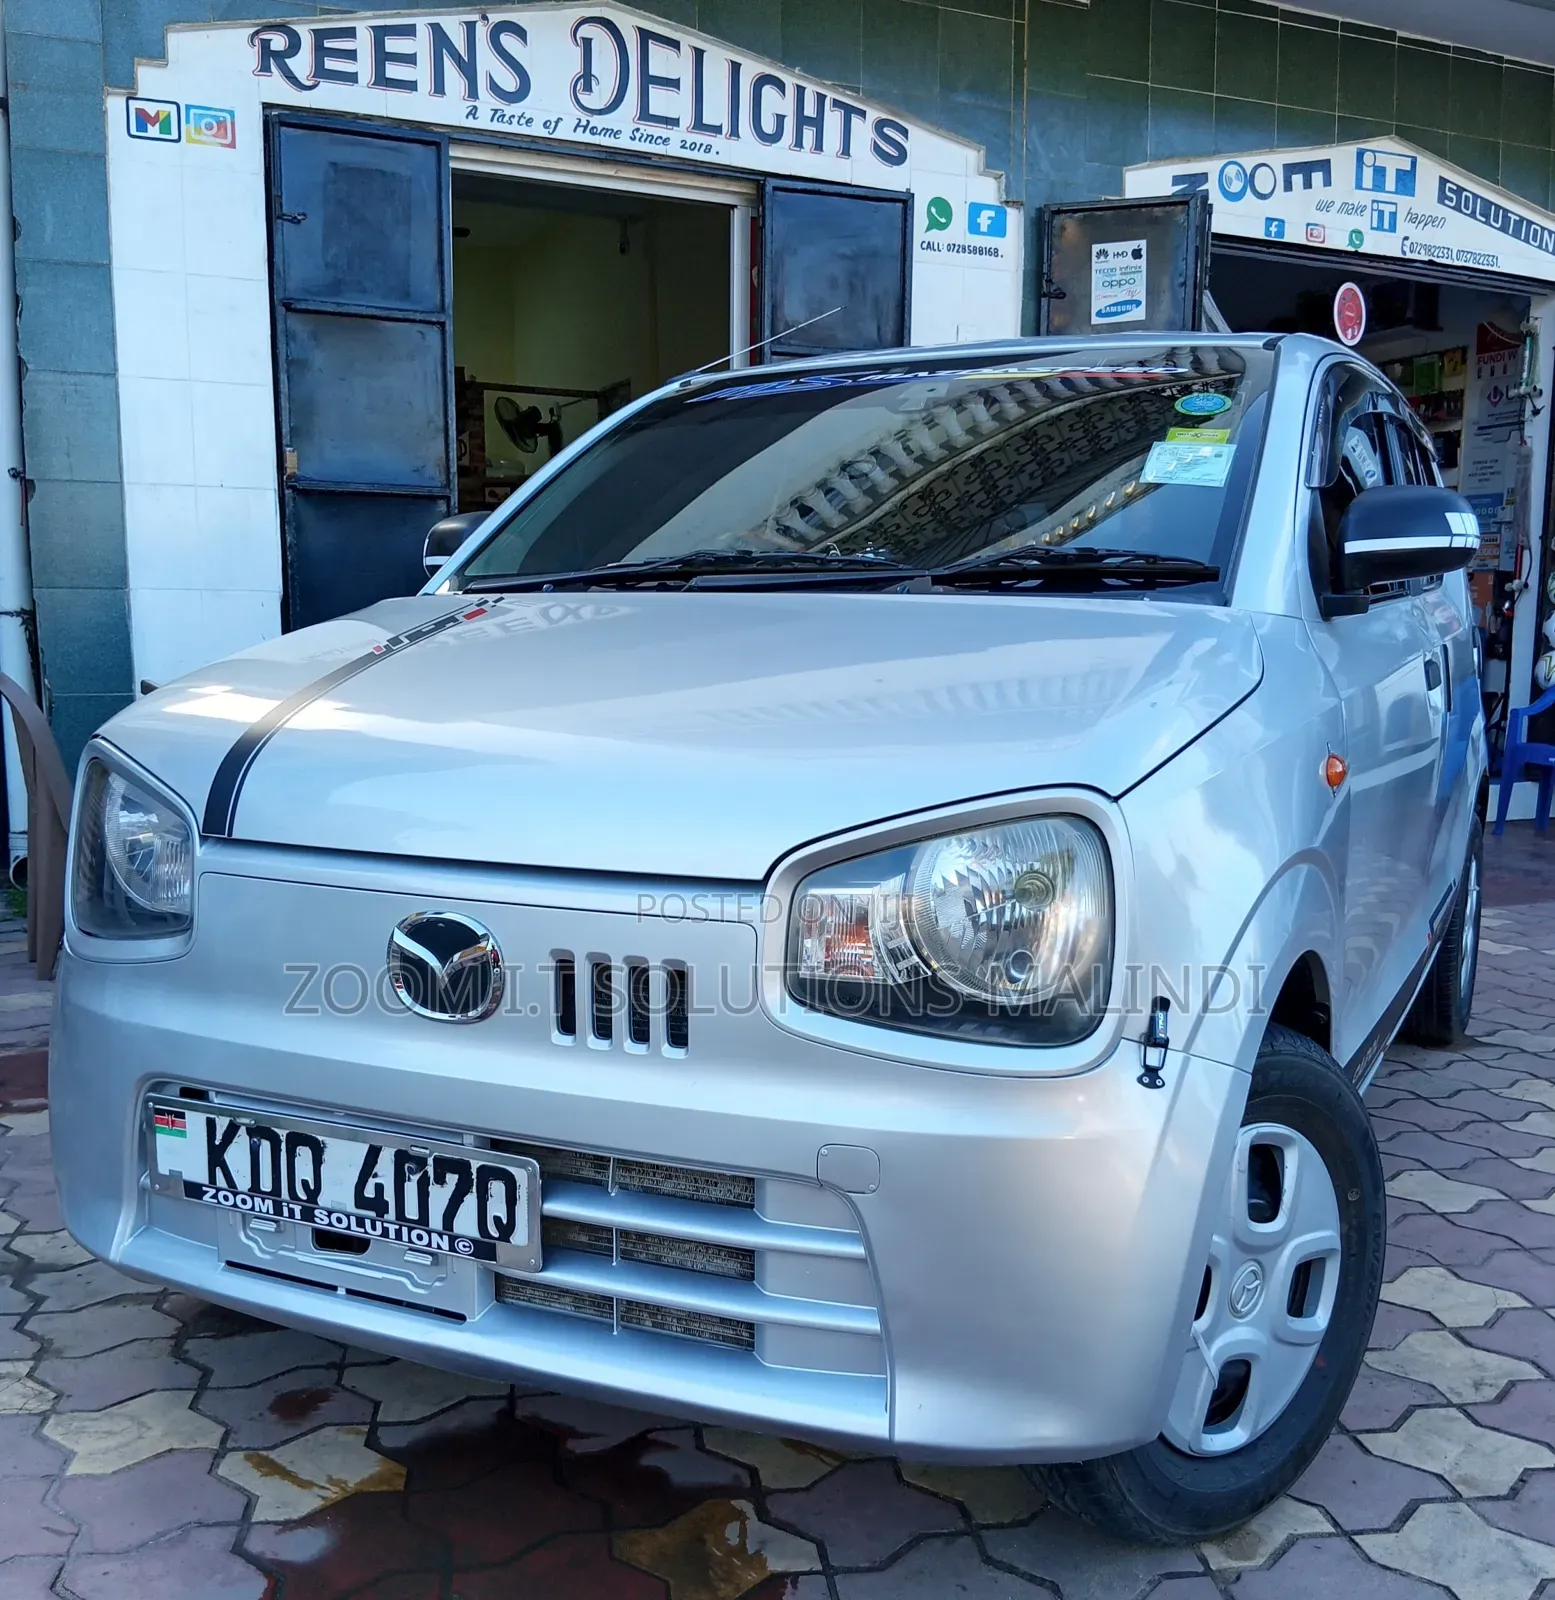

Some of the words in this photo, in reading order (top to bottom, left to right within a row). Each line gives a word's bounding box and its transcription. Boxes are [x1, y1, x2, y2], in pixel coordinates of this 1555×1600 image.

[247, 13, 532, 106] REEN'S
[569, 16, 909, 168] DELIGHTS
[465, 104, 480, 121] A
[489, 108, 533, 128] Taste
[542, 116, 563, 136] of
[572, 117, 622, 140] Home
[629, 127, 671, 147] Since
[679, 138, 720, 156] 2018.
[1315, 198, 1335, 213] we
[1336, 201, 1368, 217] make
[1403, 207, 1447, 231] happen
[1444, 182, 1555, 253] SOLUTION
[920, 239, 945, 253] CALL:
[946, 242, 1004, 259] 0728588168.
[1101, 303, 1137, 314] SAMSUNG
[201, 1186, 275, 1215] ZOOM
[206, 1115, 326, 1202] KDQ
[354, 1143, 518, 1245] 407Q
